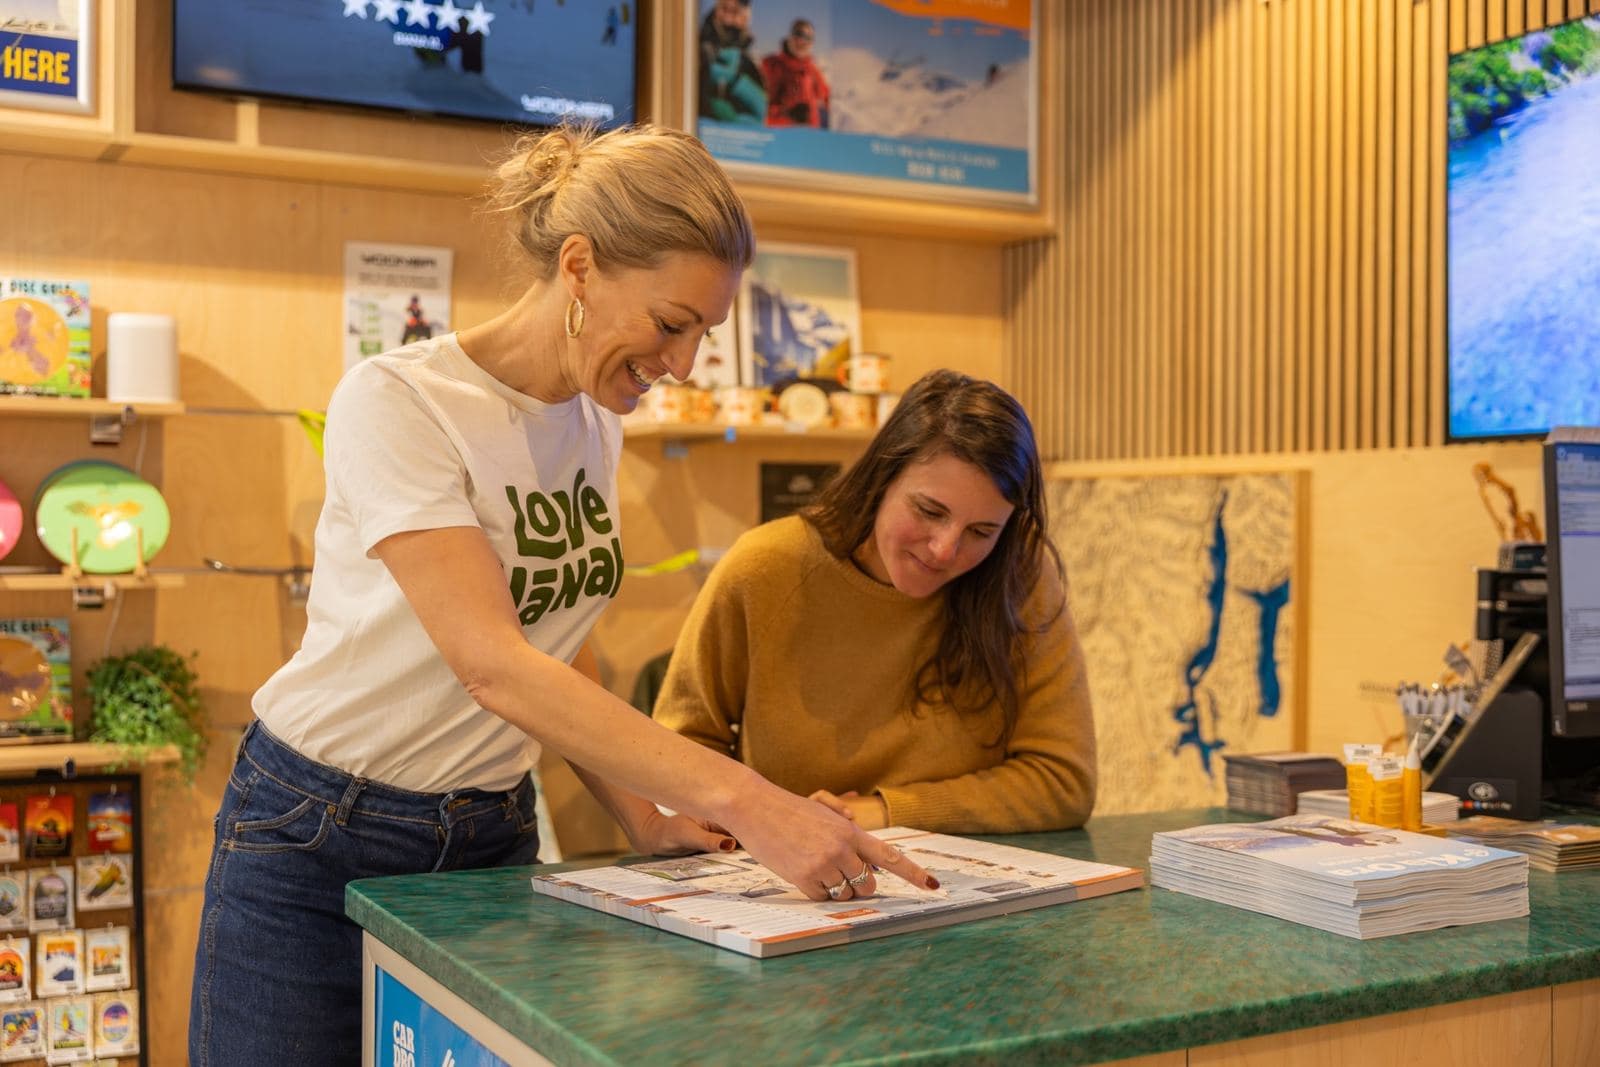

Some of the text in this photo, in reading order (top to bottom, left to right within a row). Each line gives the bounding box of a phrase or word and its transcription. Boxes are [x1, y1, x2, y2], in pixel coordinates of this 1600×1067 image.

[4, 46, 70, 85] HERE
[10, 281, 35, 293] DISC
[393, 1020, 415, 1053] CAR
